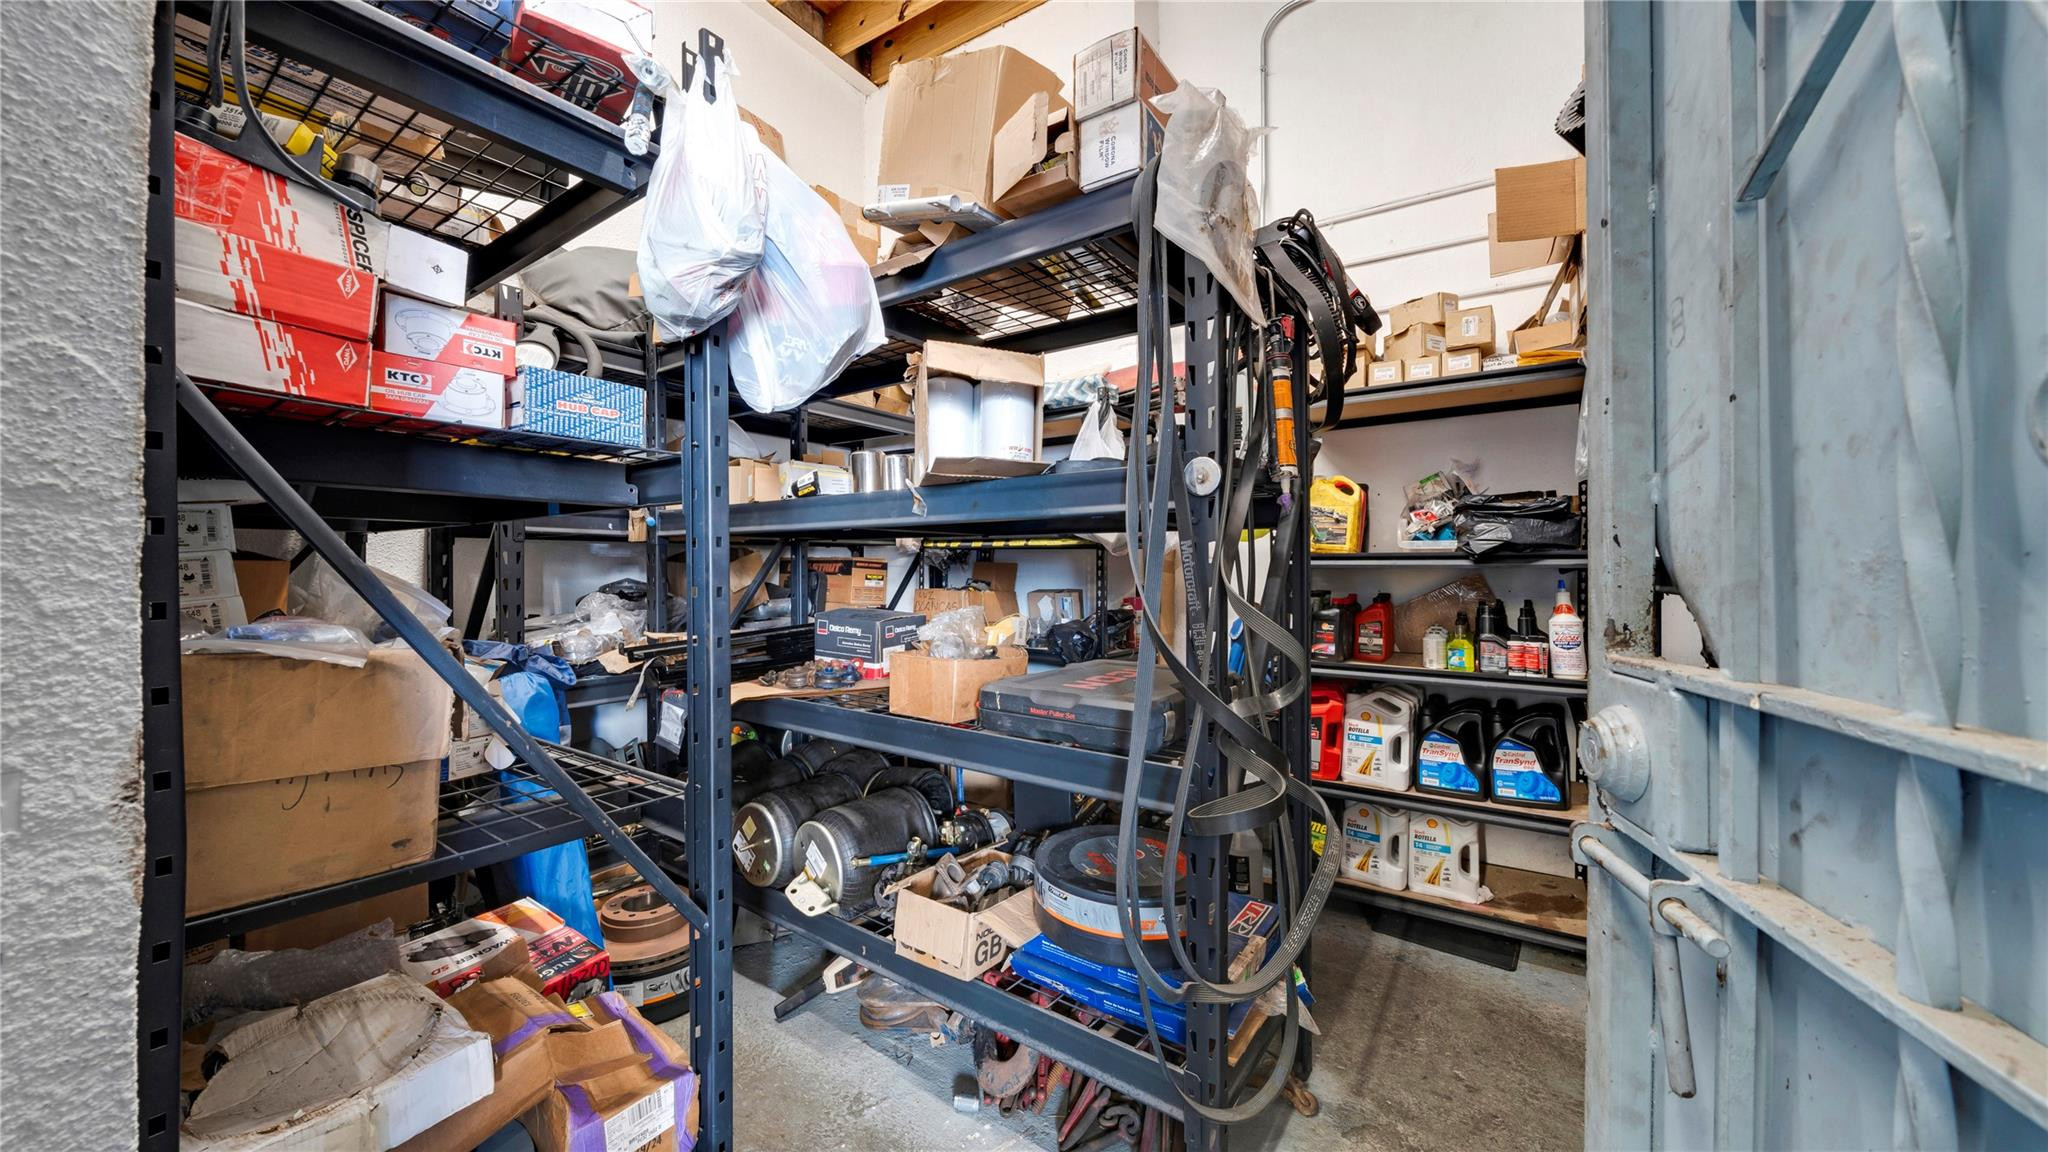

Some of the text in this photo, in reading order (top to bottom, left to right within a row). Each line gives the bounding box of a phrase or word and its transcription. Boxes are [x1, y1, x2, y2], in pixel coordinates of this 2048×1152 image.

[473, 345, 502, 360] KTC
[386, 370, 420, 384] KTC
[556, 401, 620, 418] HUB CAP
[1181, 540, 1201, 613] Motorcraft
[829, 624, 862, 637] Delco Remy
[1029, 706, 1049, 717] Master
[1065, 711, 1076, 720] Set
[1422, 747, 1460, 759] TranSynd
[1495, 756, 1537, 767] TranSynd
[1310, 821, 1329, 835] me
[1346, 822, 1368, 831] ROTELLA
[1414, 833, 1437, 842] ROTELLA
[974, 934, 1003, 967] GB
